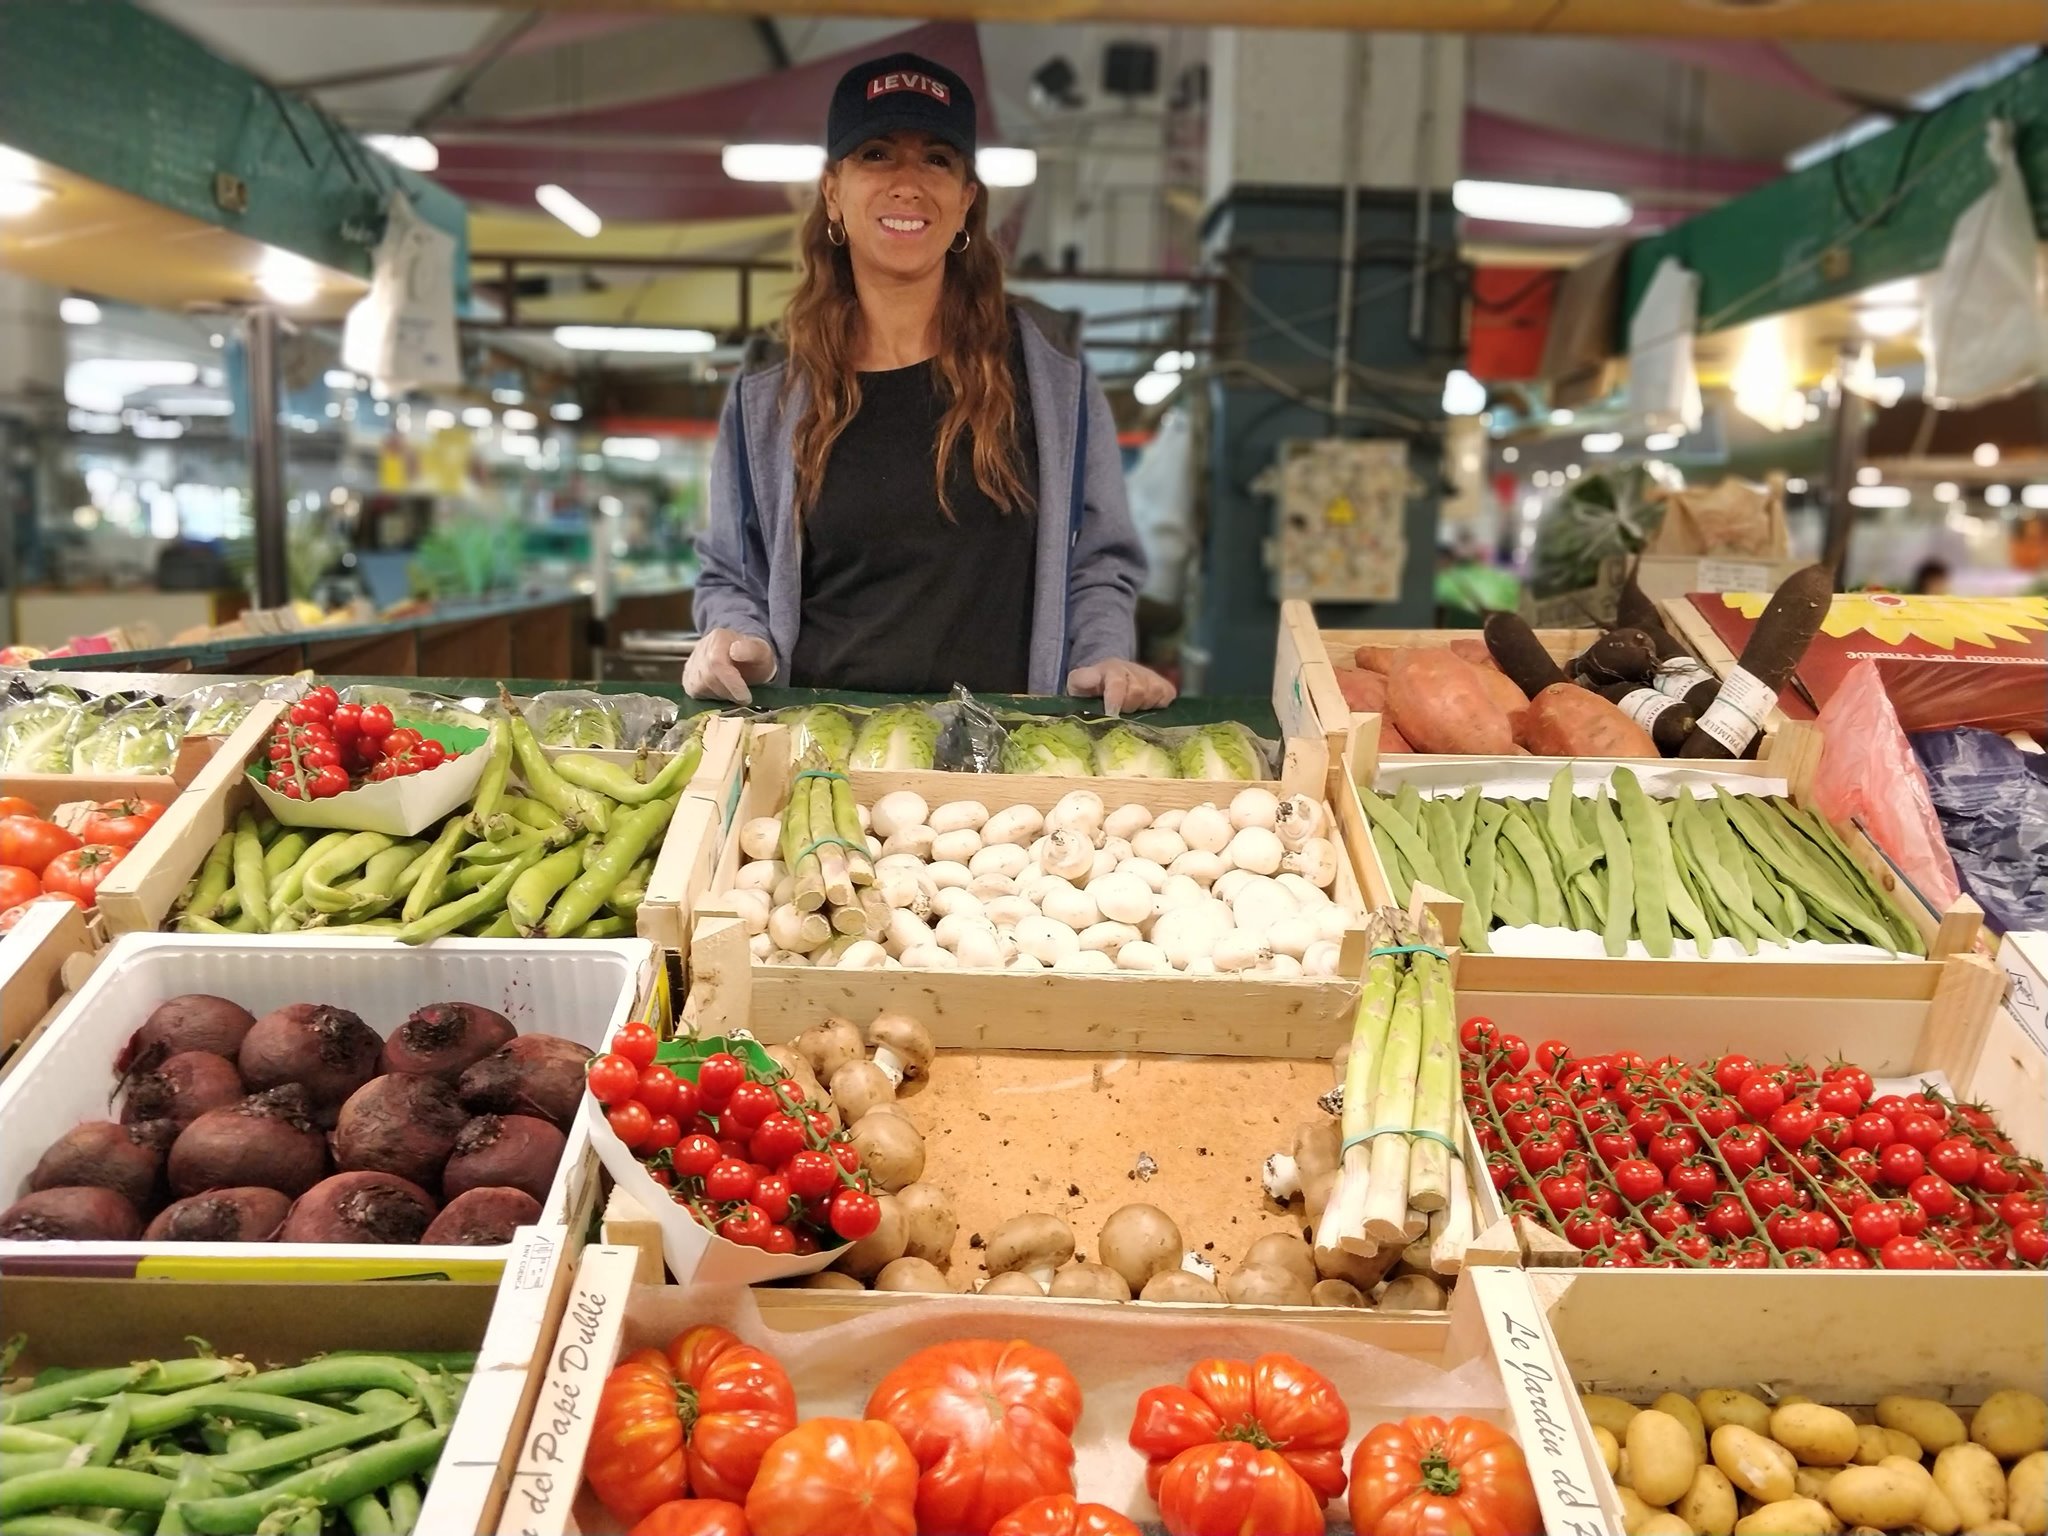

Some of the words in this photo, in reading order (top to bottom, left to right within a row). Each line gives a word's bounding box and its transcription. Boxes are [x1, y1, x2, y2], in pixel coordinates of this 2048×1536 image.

[873, 73, 945, 98] LEVI'S
[1502, 1311, 1540, 1350] Le
[530, 1381, 581, 1462] Papé
[558, 1290, 607, 1373] Dublé
[1504, 1359, 1566, 1457] Jardin
